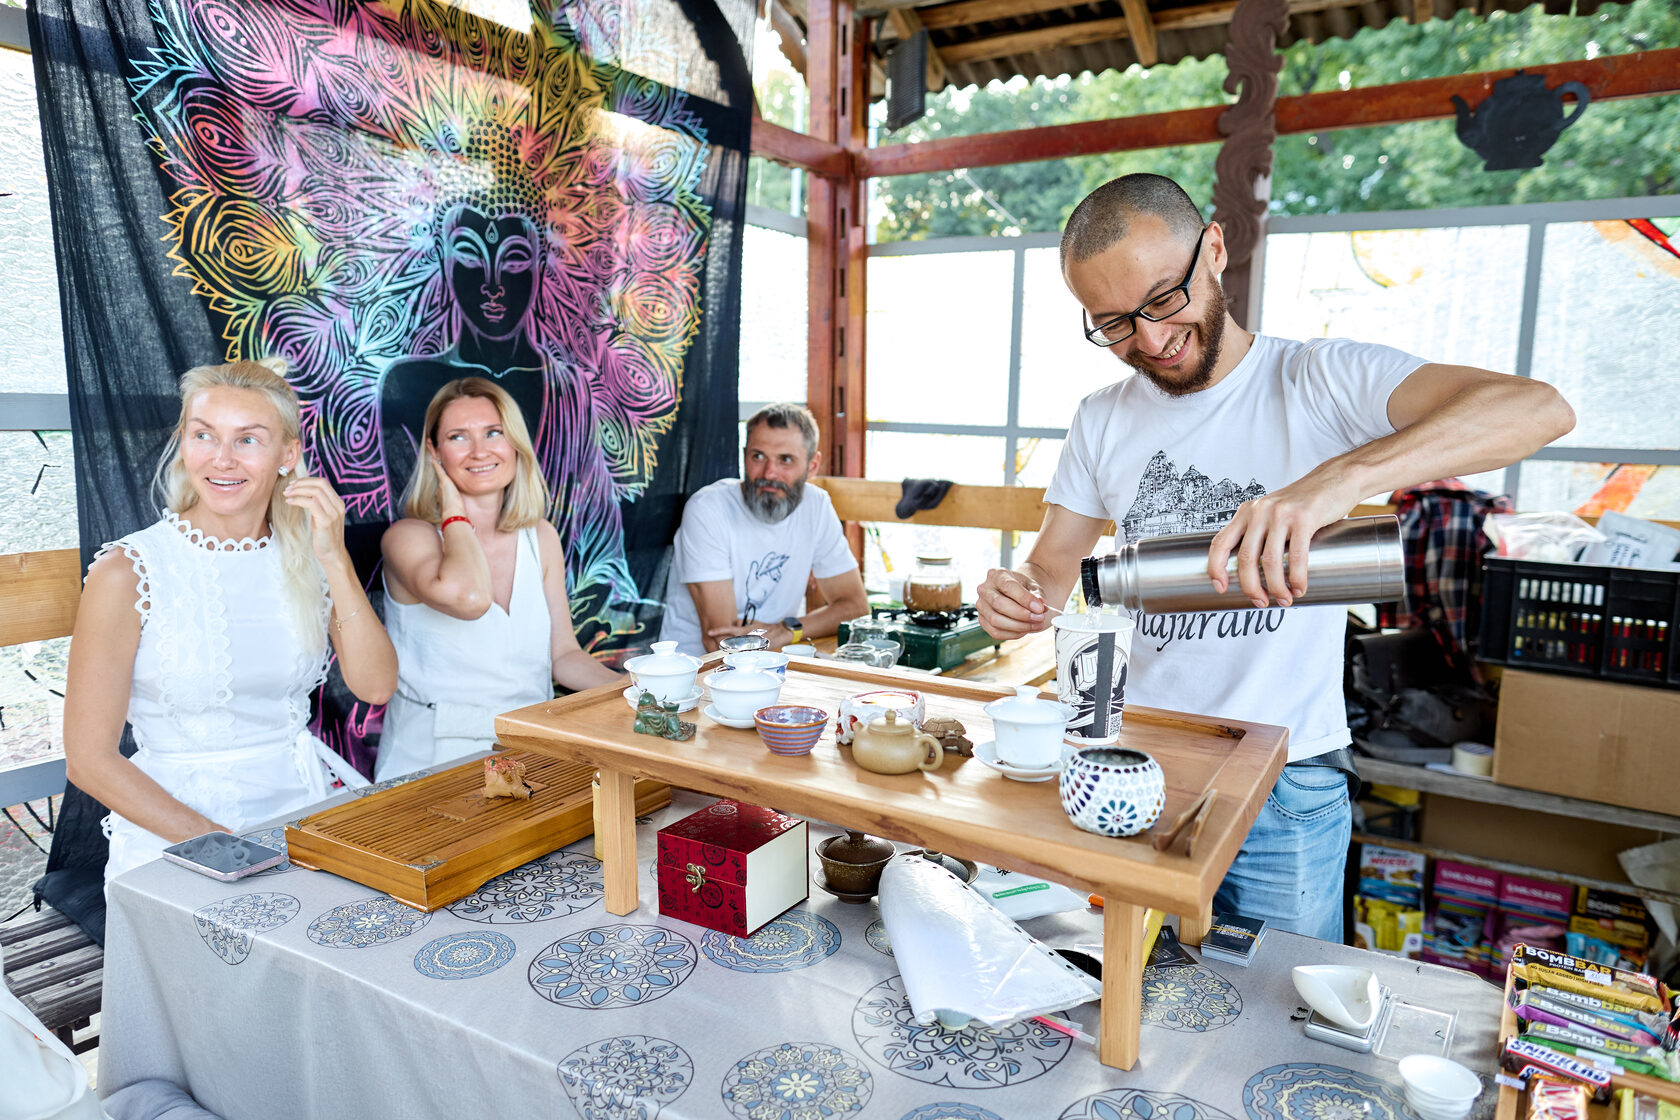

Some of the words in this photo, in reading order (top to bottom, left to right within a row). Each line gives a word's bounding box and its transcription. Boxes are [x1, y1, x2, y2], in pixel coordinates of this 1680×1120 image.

[1526, 946, 1612, 975] BOMBBAR
[1530, 997, 1630, 1034] #Bombbar
[1535, 1023, 1640, 1054] #Bombbar
